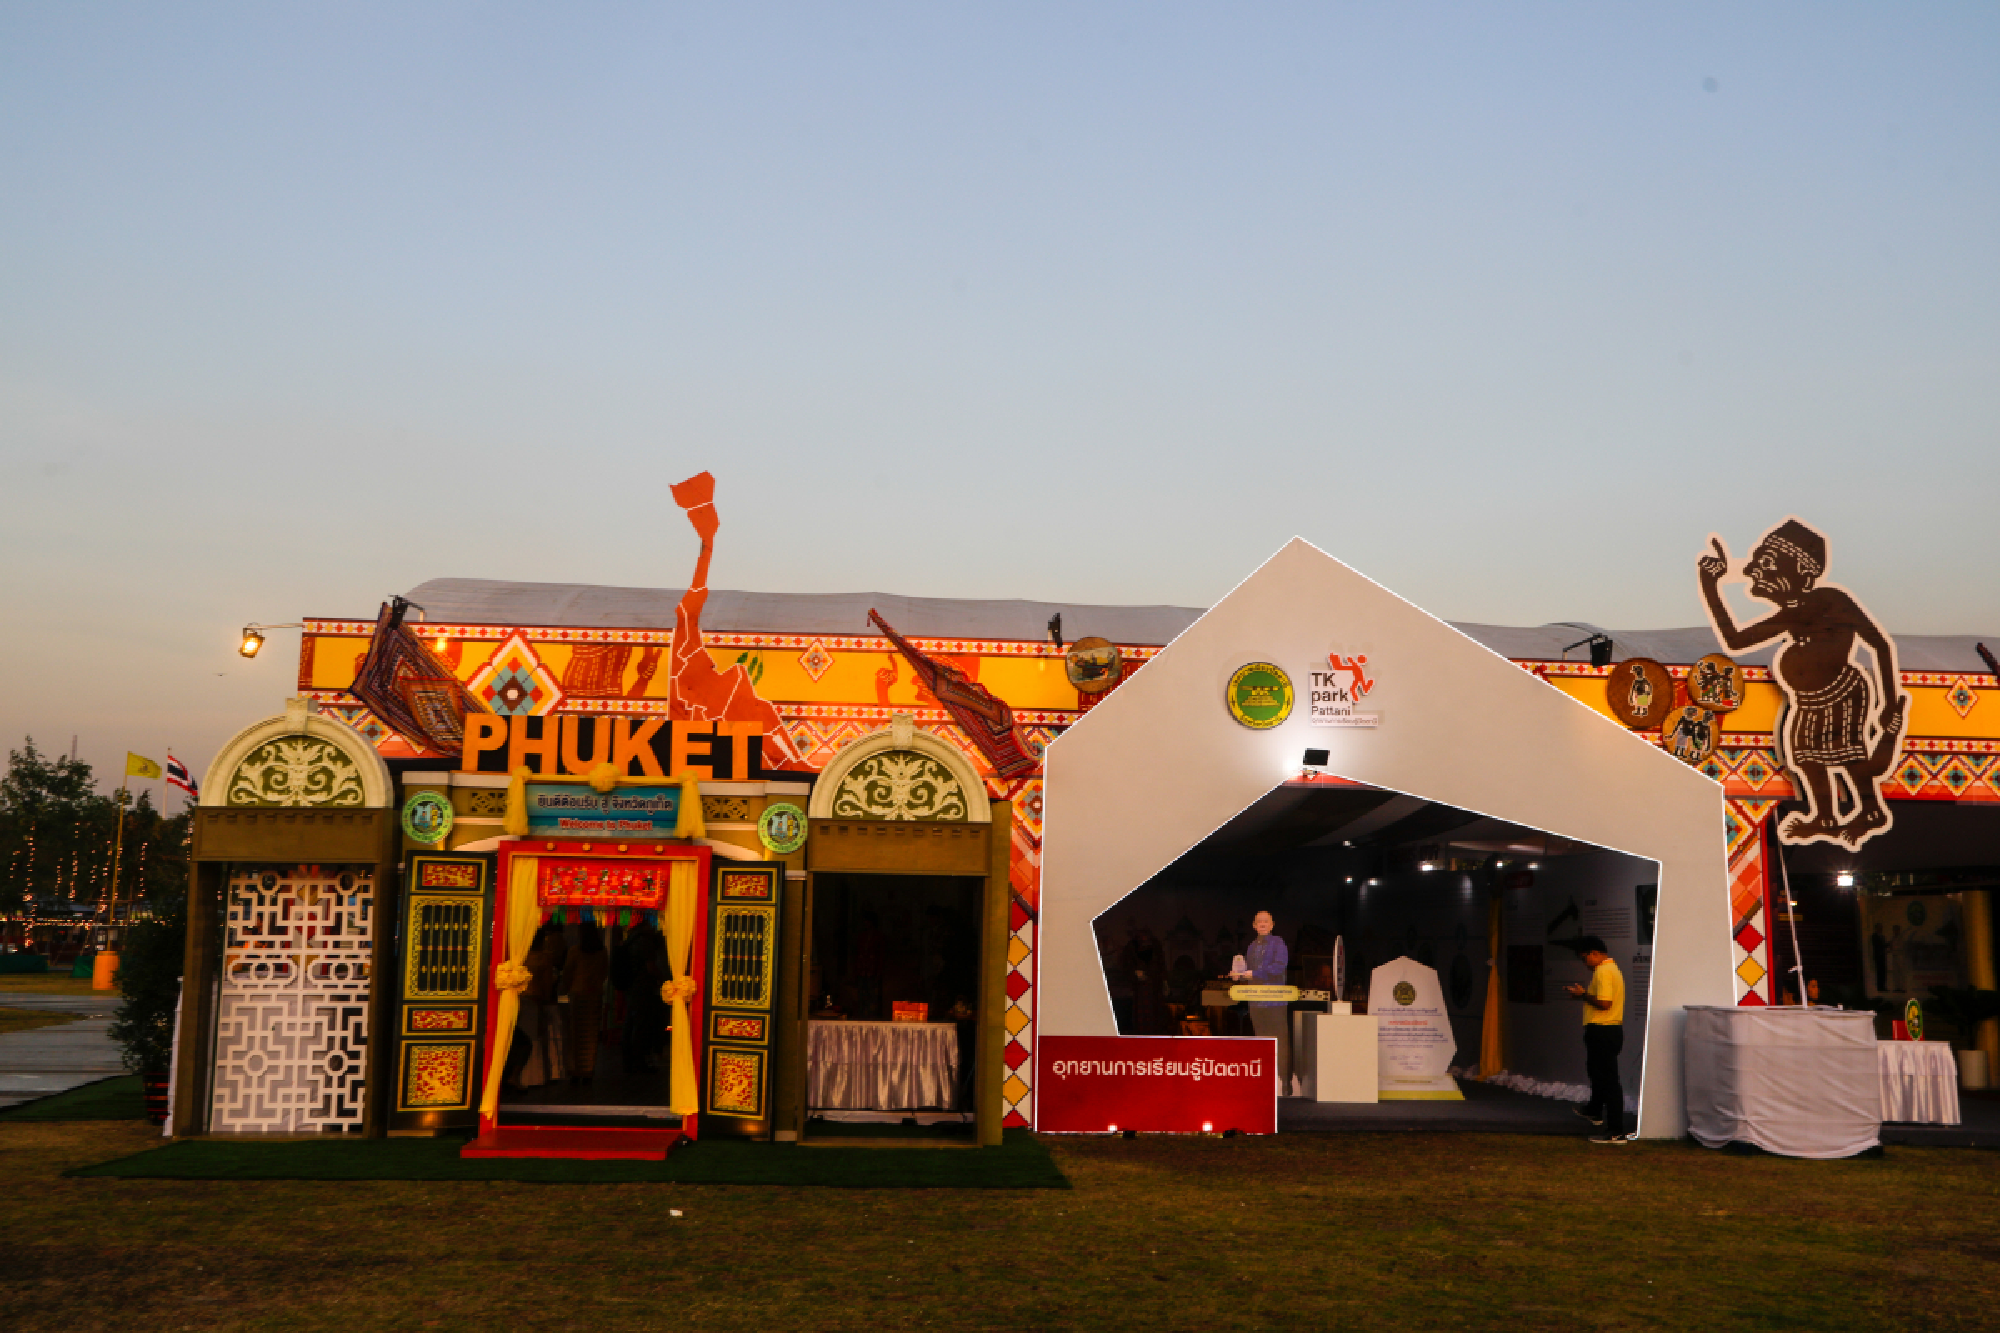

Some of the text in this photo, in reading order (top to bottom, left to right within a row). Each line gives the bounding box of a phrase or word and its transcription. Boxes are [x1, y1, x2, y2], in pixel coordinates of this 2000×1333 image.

[1311, 672, 1336, 687] TK
[1311, 688, 1349, 705] park
[1311, 705, 1351, 716] Pattani
[462, 712, 763, 780] PHUKET
[558, 818, 653, 831] Welcome to Phuket
[1053, 1056, 1262, 1081] อุทยานการเรียนรู้ปัตตานี
